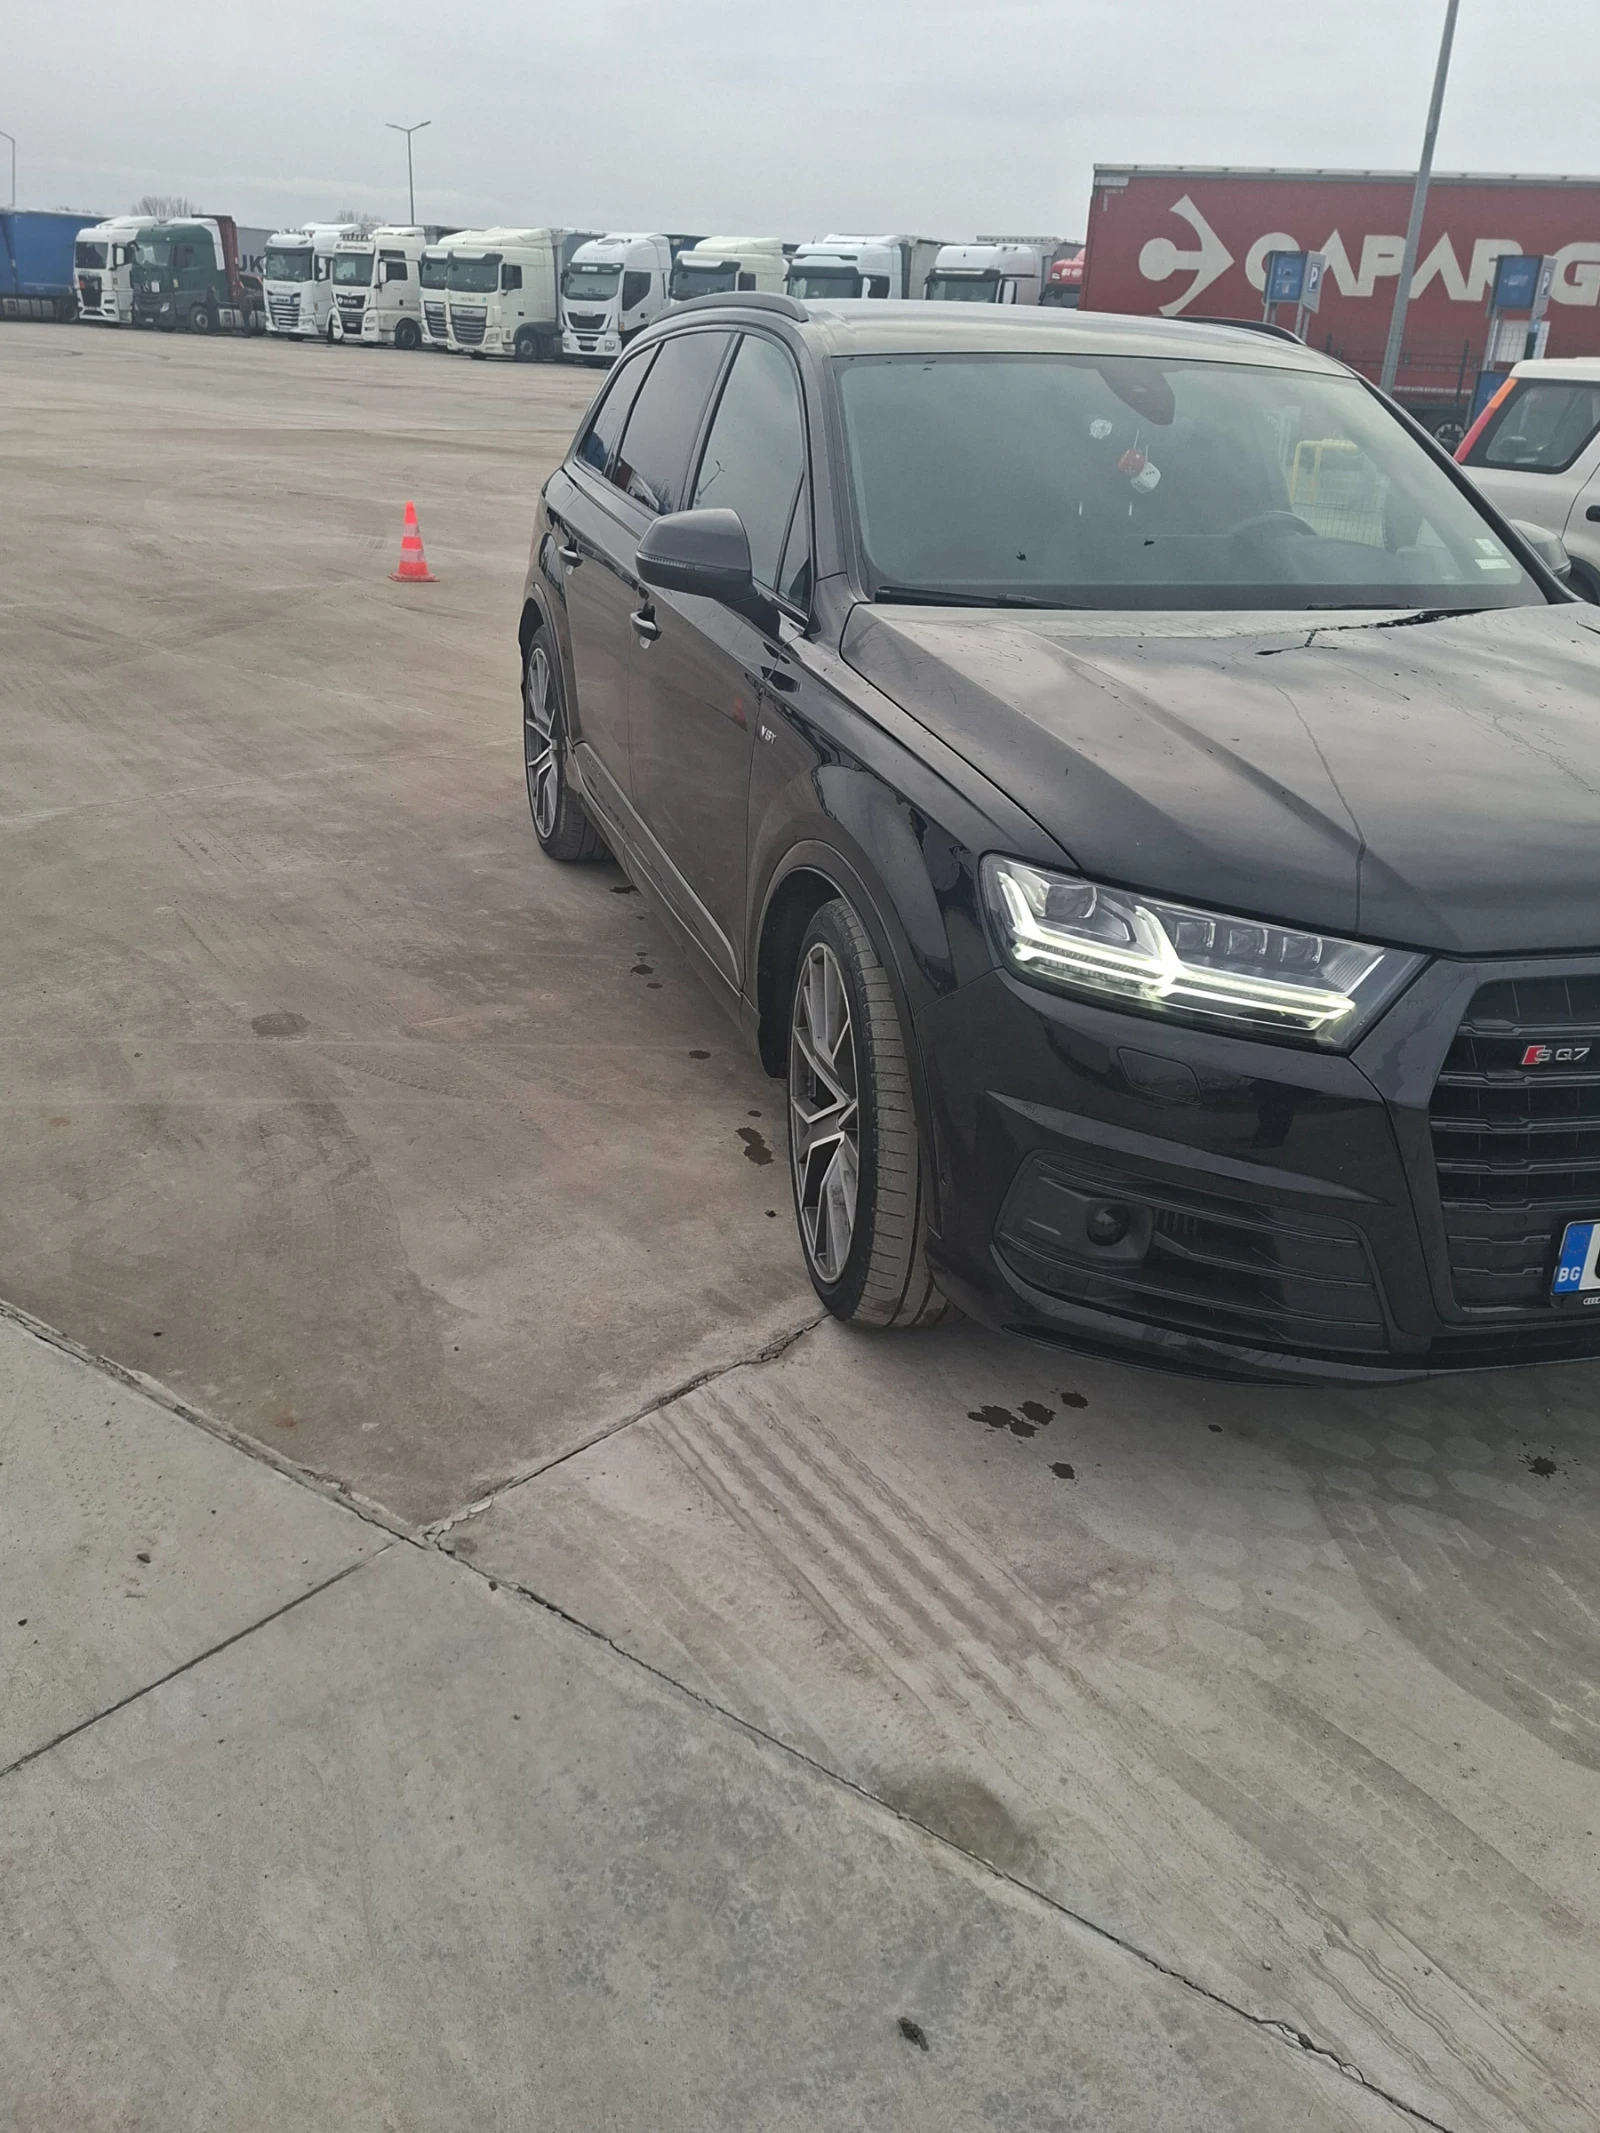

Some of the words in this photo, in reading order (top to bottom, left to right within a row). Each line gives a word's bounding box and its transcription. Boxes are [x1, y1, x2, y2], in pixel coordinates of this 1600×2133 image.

[1309, 266, 1319, 289] P
[1534, 1047, 1591, 1062] SQ7
[1557, 1265, 1582, 1283] BG
